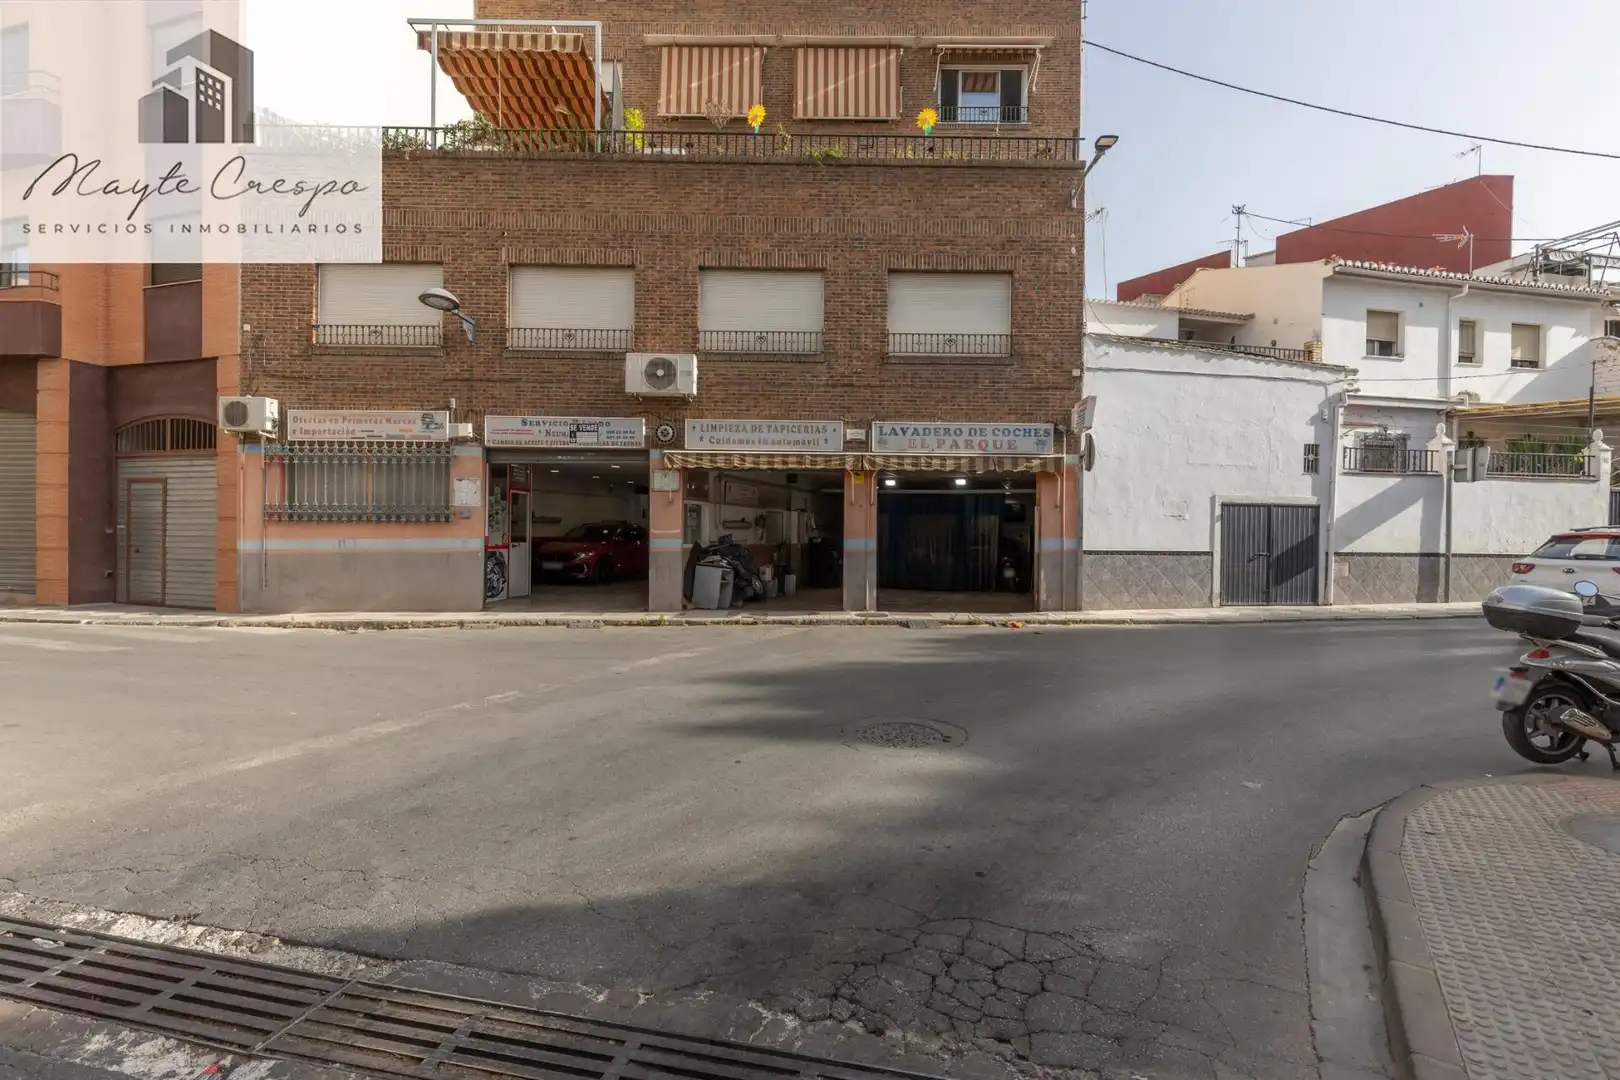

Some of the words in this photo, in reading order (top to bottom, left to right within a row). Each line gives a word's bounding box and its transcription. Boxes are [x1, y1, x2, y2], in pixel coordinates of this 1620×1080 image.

[569, 424, 578, 432] SE
[578, 424, 598, 432] VENDE
[700, 423, 749, 433] LIMPIEZA
[751, 424, 765, 434] DE
[877, 425, 964, 437] LAVADERO
[967, 427, 988, 438] DE
[991, 427, 1052, 438] COCHES
[907, 438, 930, 449] EL
[936, 438, 1017, 451] PARQUE
